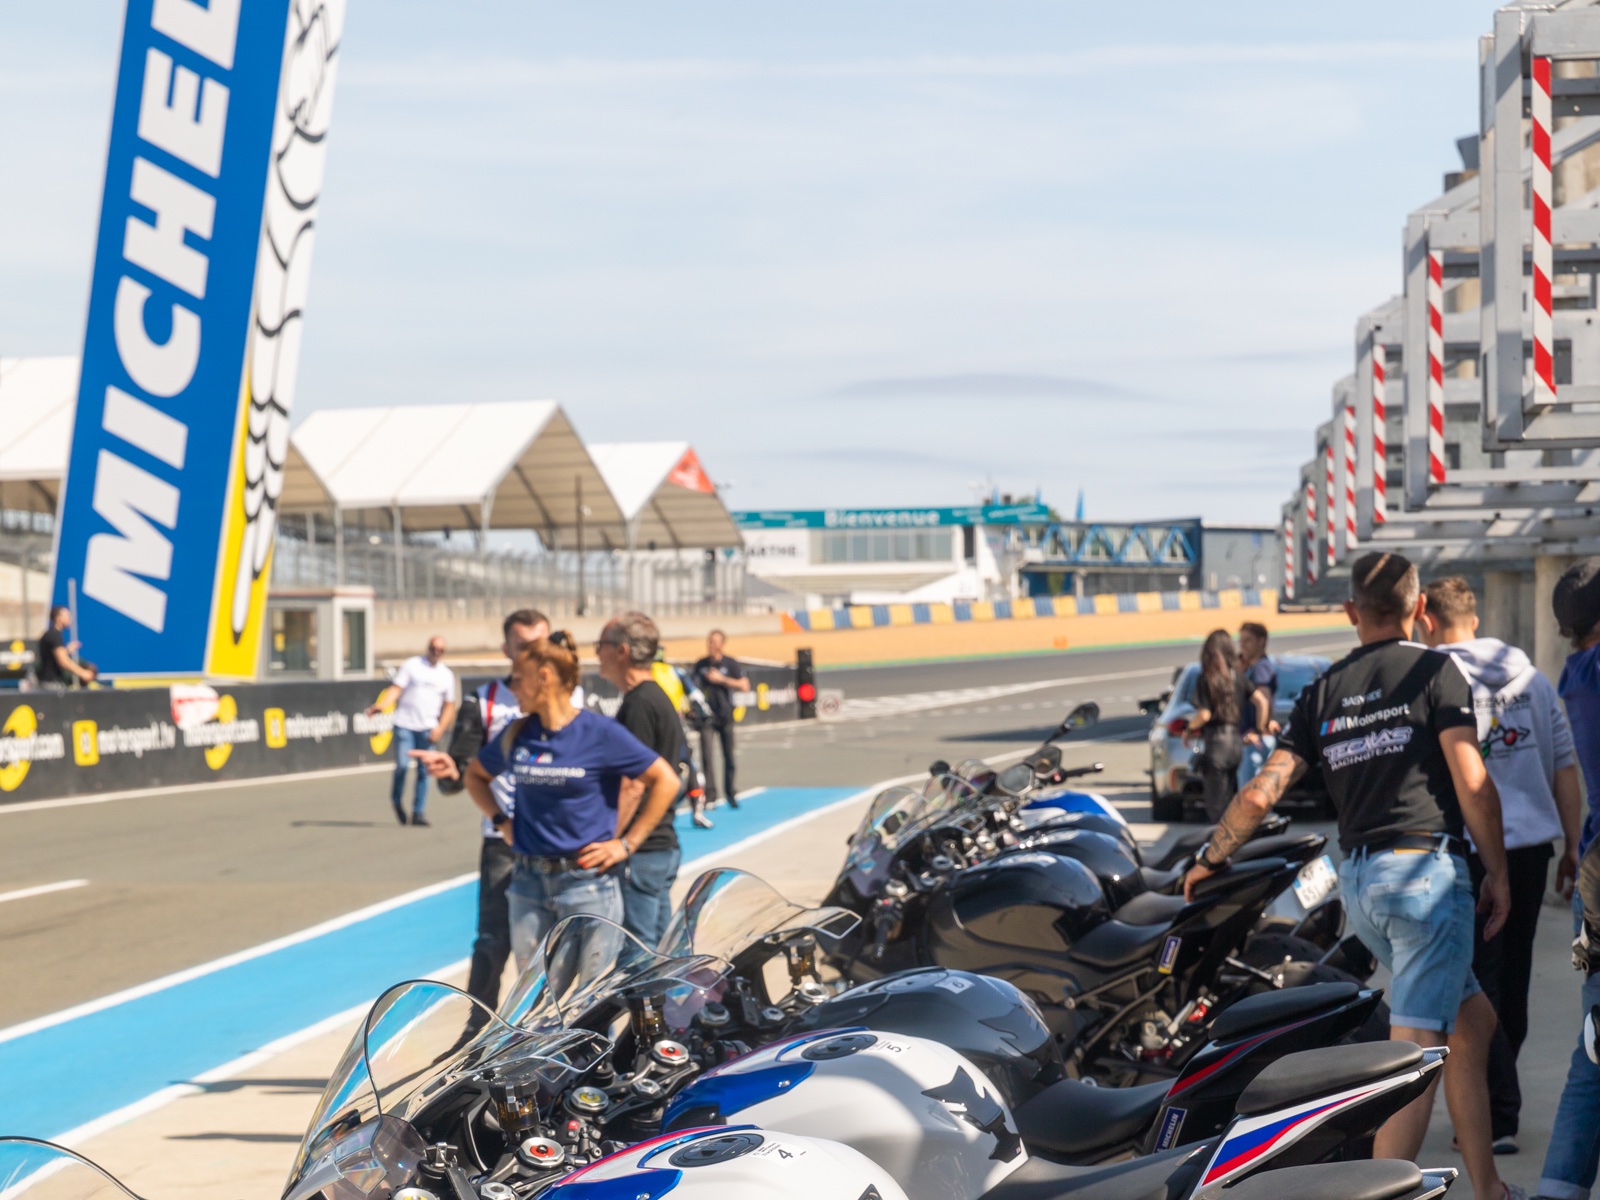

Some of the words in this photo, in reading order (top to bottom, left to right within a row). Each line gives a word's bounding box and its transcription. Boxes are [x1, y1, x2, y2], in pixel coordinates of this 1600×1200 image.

[824, 508, 940, 528] Bienvenue
[1346, 703, 1410, 729] Motorsport
[886, 1043, 902, 1053] 5
[1162, 1113, 1179, 1149] MICHELIN
[778, 1148, 794, 1160] 4
